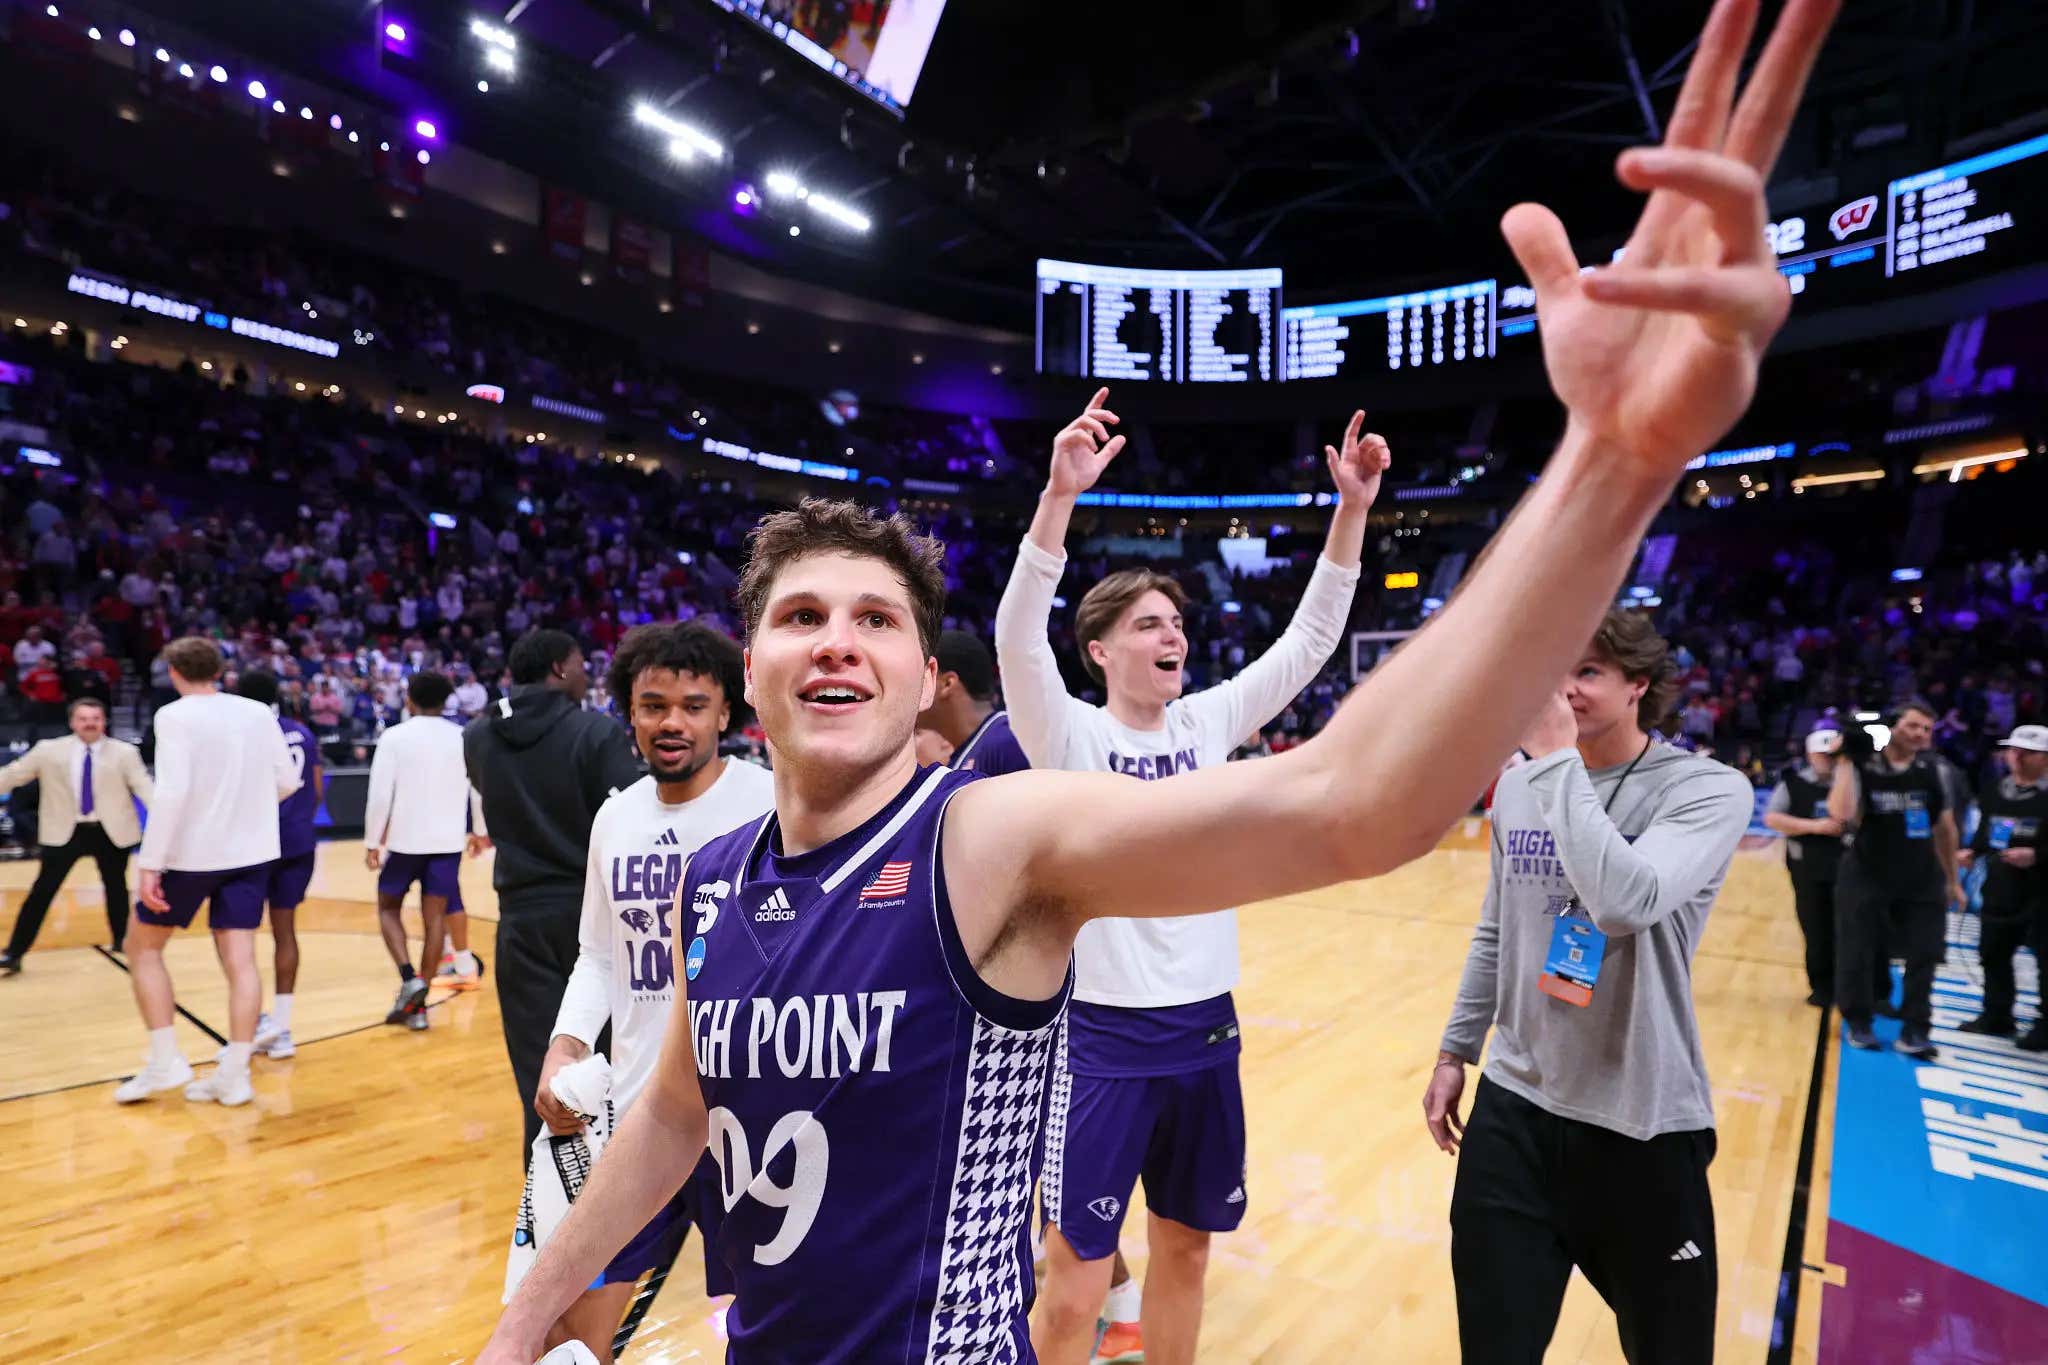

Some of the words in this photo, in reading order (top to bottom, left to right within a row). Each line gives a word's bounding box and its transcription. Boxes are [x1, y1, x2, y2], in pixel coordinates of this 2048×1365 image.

[612, 852, 697, 901] LEGA
[755, 908, 795, 922] adidas
[625, 940, 674, 991] LO
[687, 999, 740, 1078] IGH
[748, 990, 907, 1079] POINT
